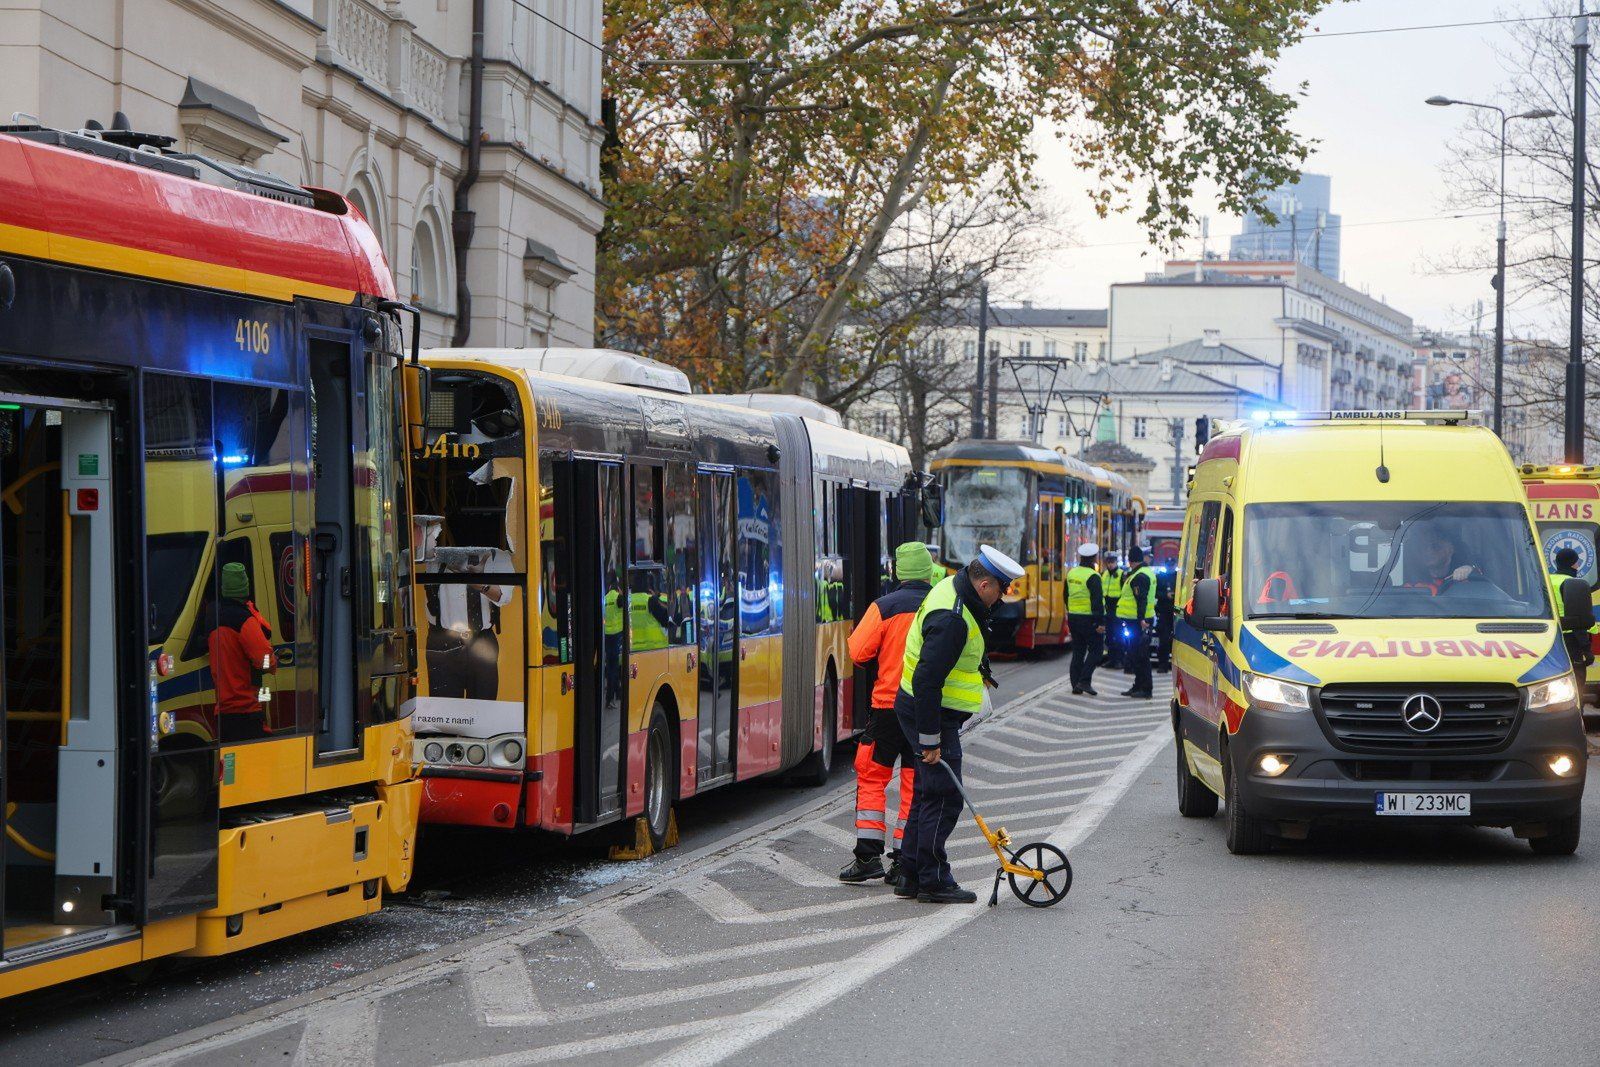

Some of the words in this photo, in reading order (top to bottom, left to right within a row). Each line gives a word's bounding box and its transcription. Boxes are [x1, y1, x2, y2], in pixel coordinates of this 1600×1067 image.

[235, 318, 270, 355] 4106
[1334, 411, 1402, 419] AMBULANS
[1530, 503, 1593, 519] LANS
[1387, 795, 1406, 811] WI
[1415, 795, 1466, 811] 233MC
